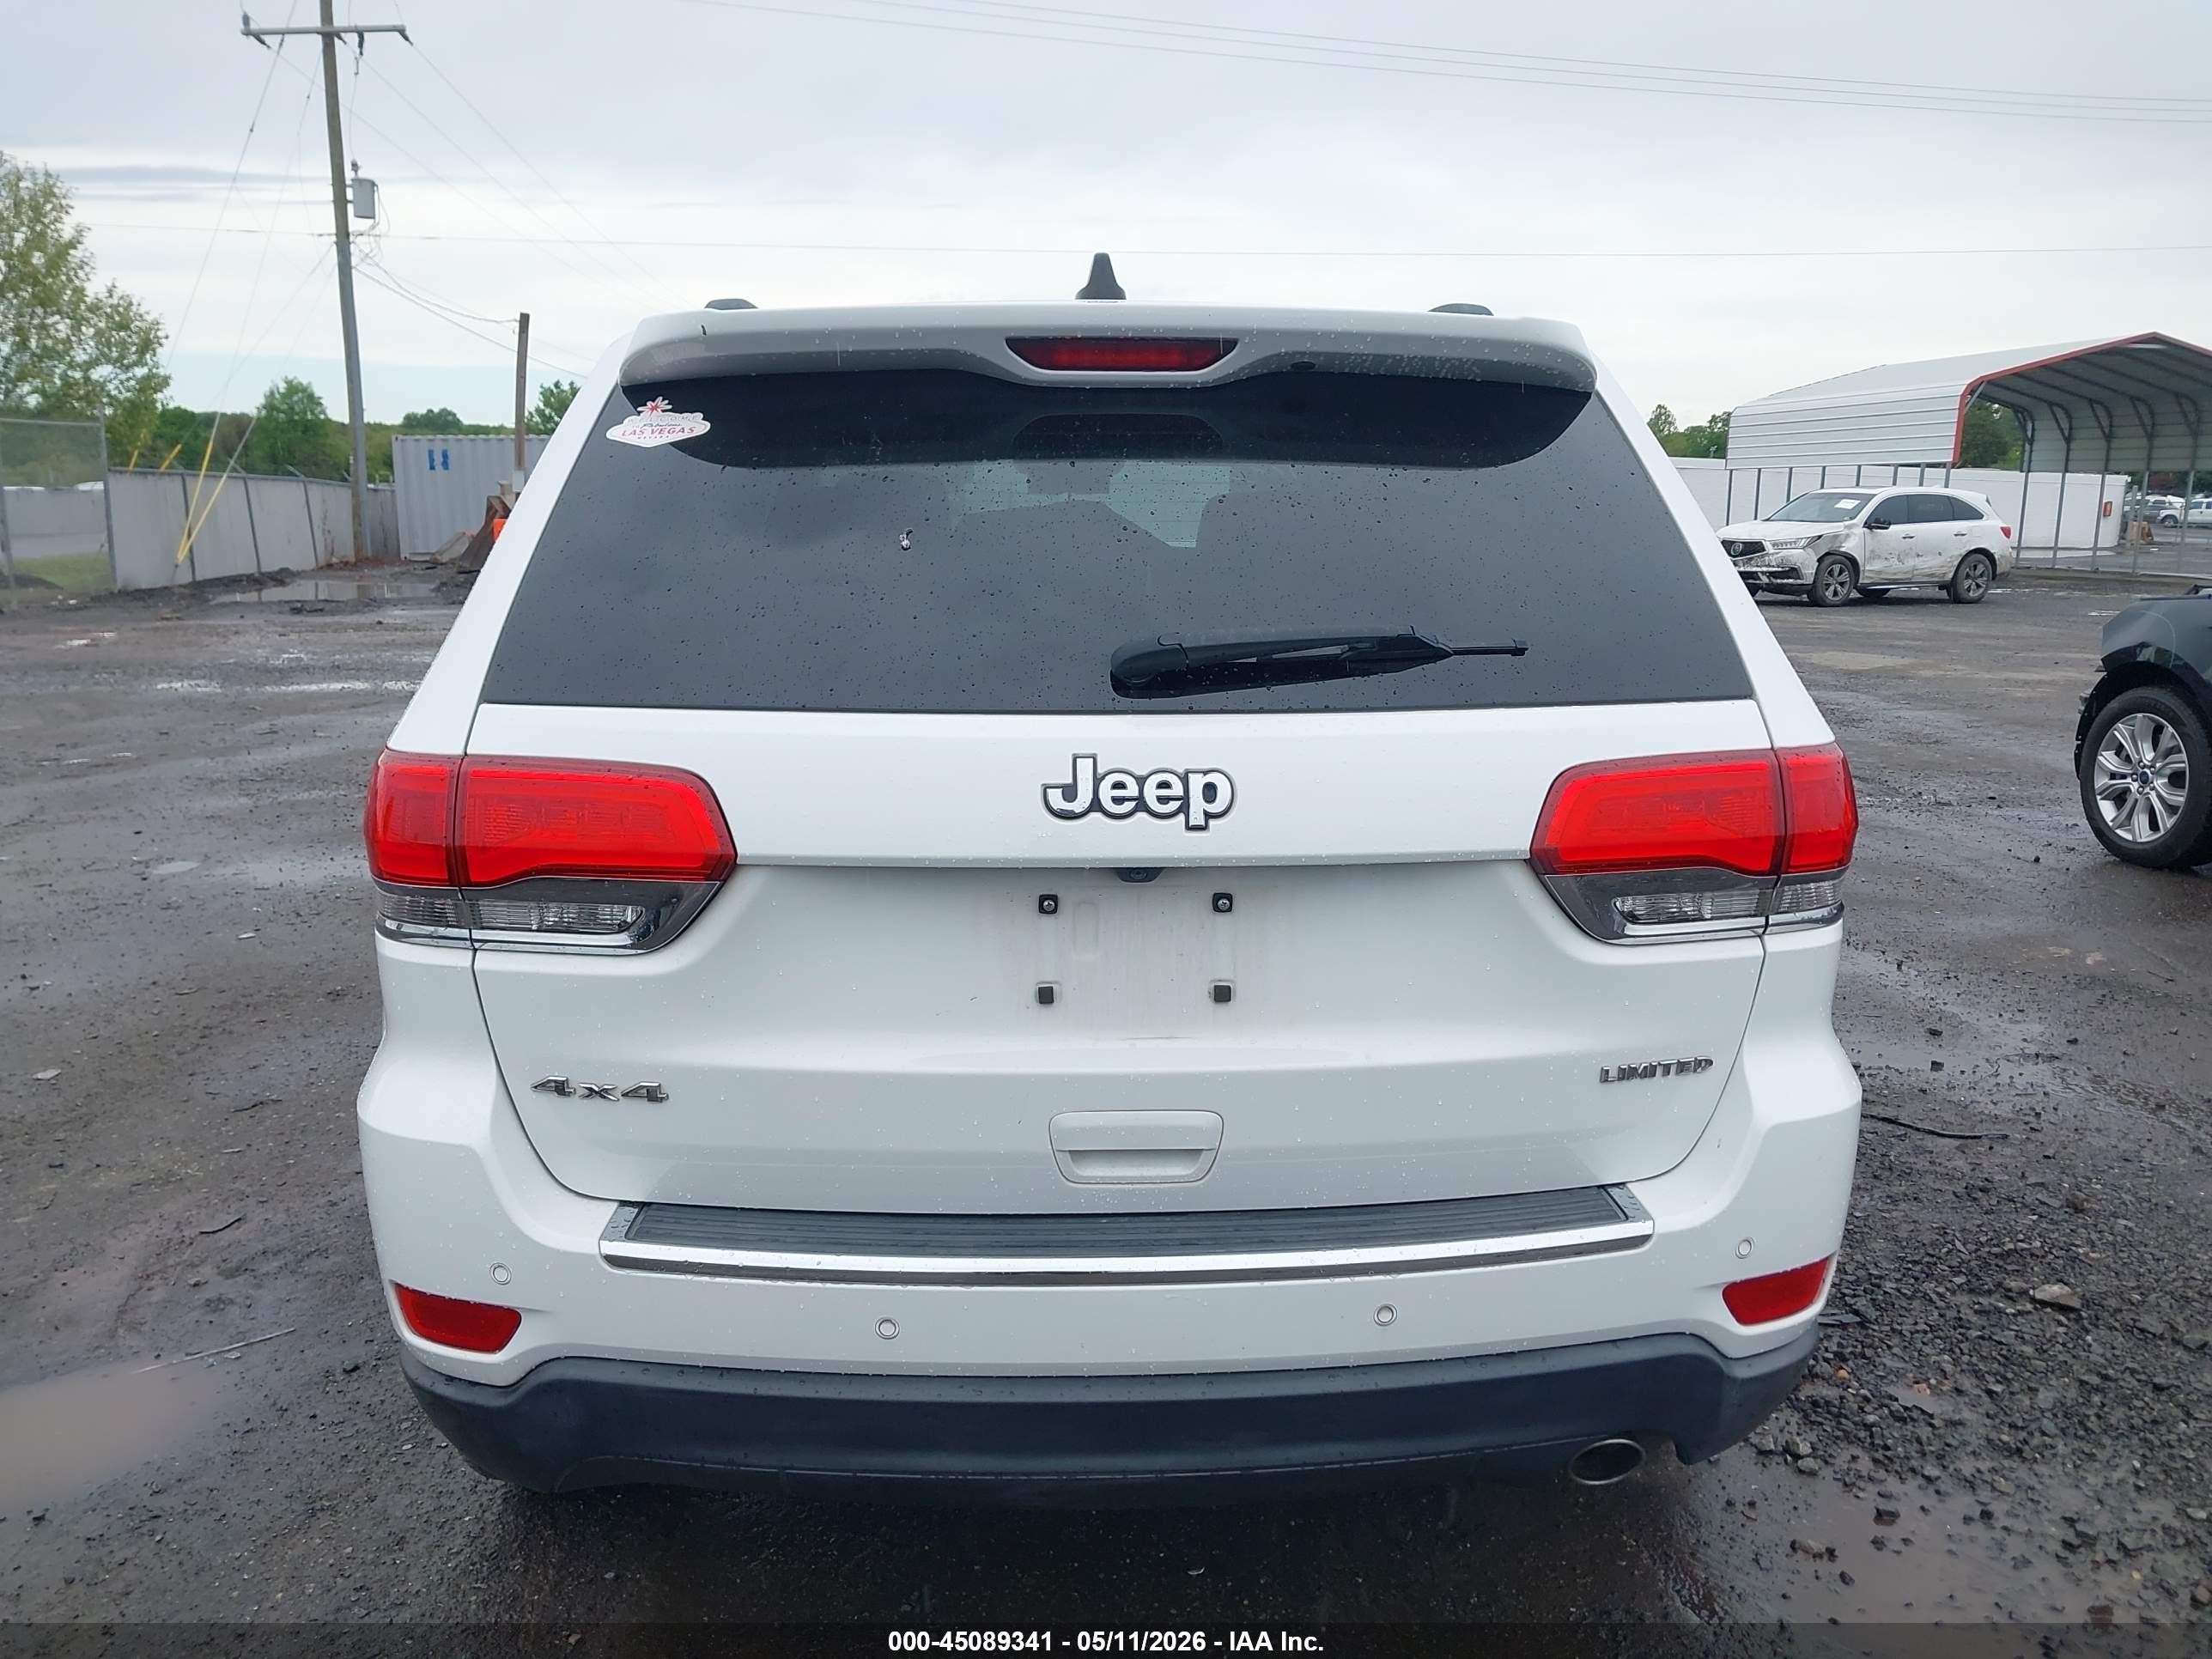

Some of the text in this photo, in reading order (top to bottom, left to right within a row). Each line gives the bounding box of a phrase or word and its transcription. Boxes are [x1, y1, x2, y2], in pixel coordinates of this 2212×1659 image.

[651, 426, 696, 435] VEGAS
[1041, 753, 1237, 830] Jeep
[1599, 1055, 1714, 1083] LIMITED
